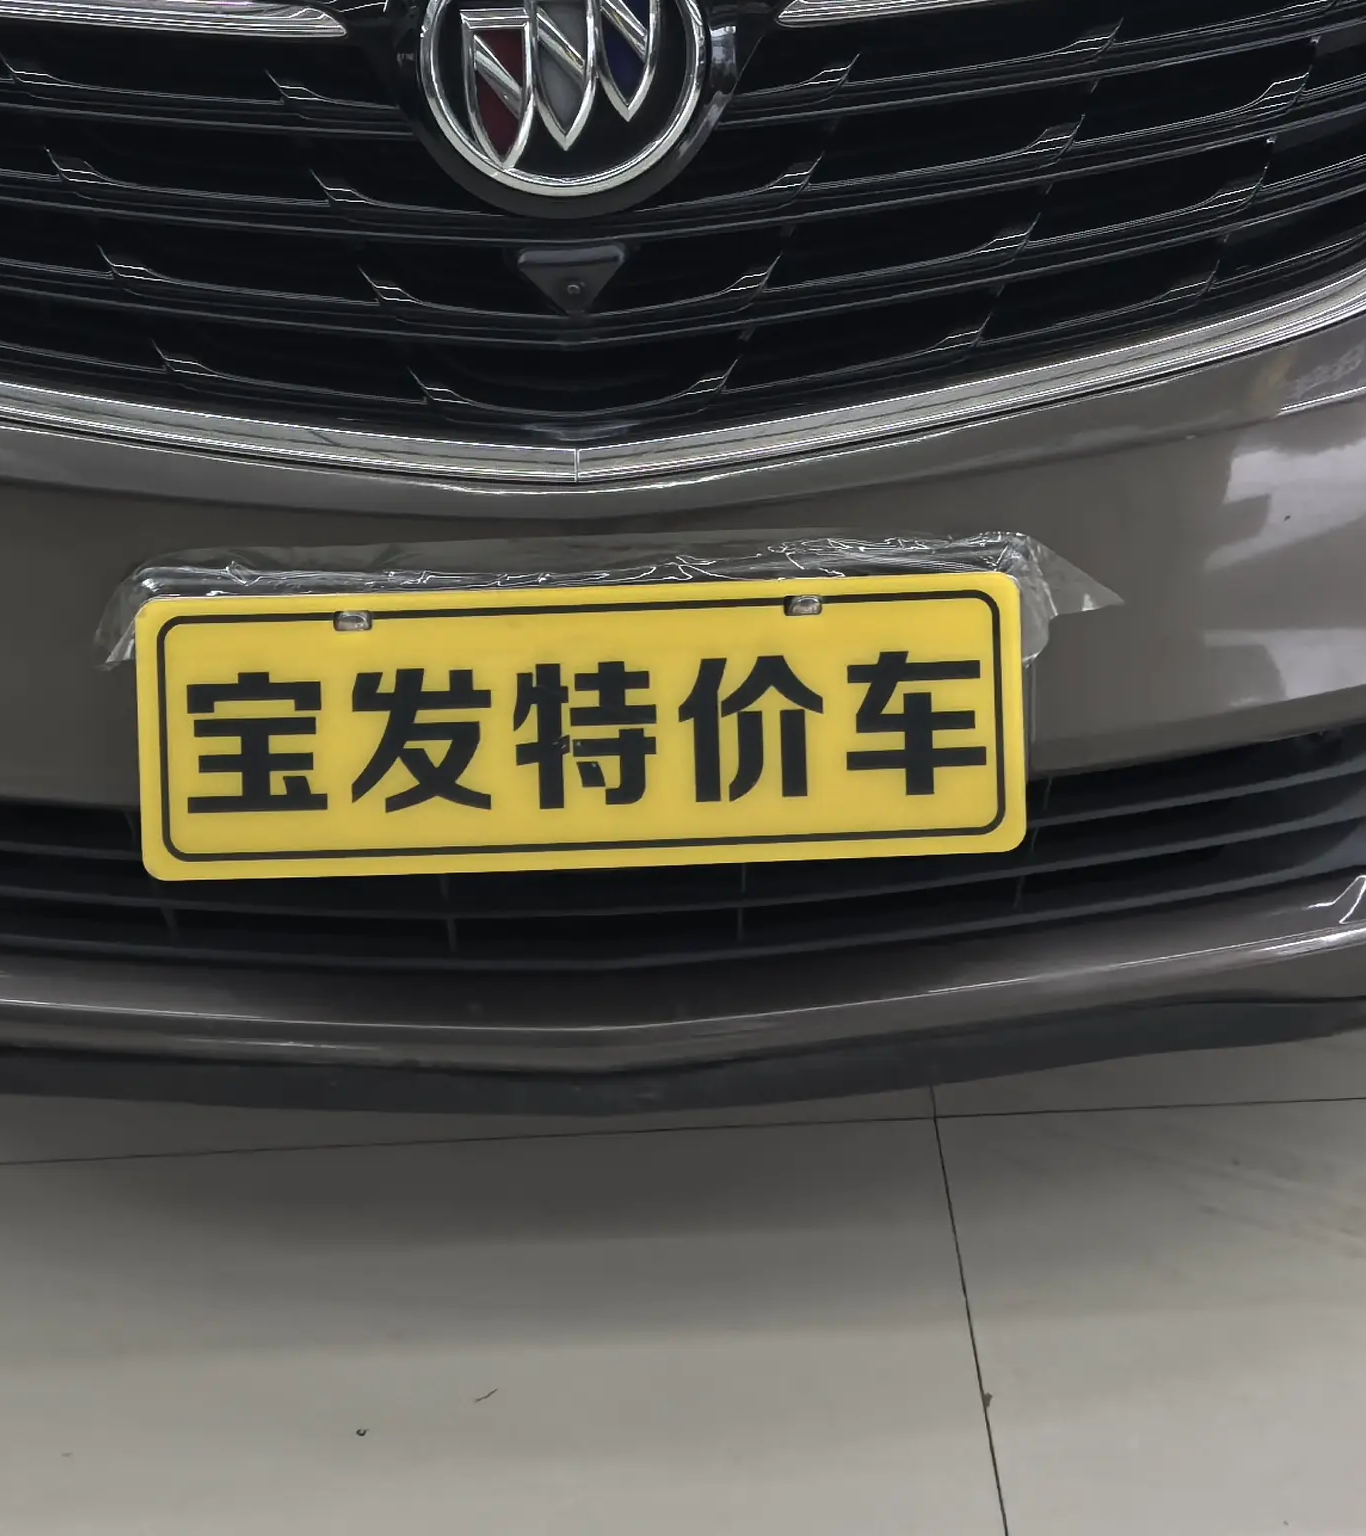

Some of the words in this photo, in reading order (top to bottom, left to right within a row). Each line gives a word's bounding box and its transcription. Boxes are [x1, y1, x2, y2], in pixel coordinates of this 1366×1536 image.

[186, 649, 988, 814] 宝发特价车
